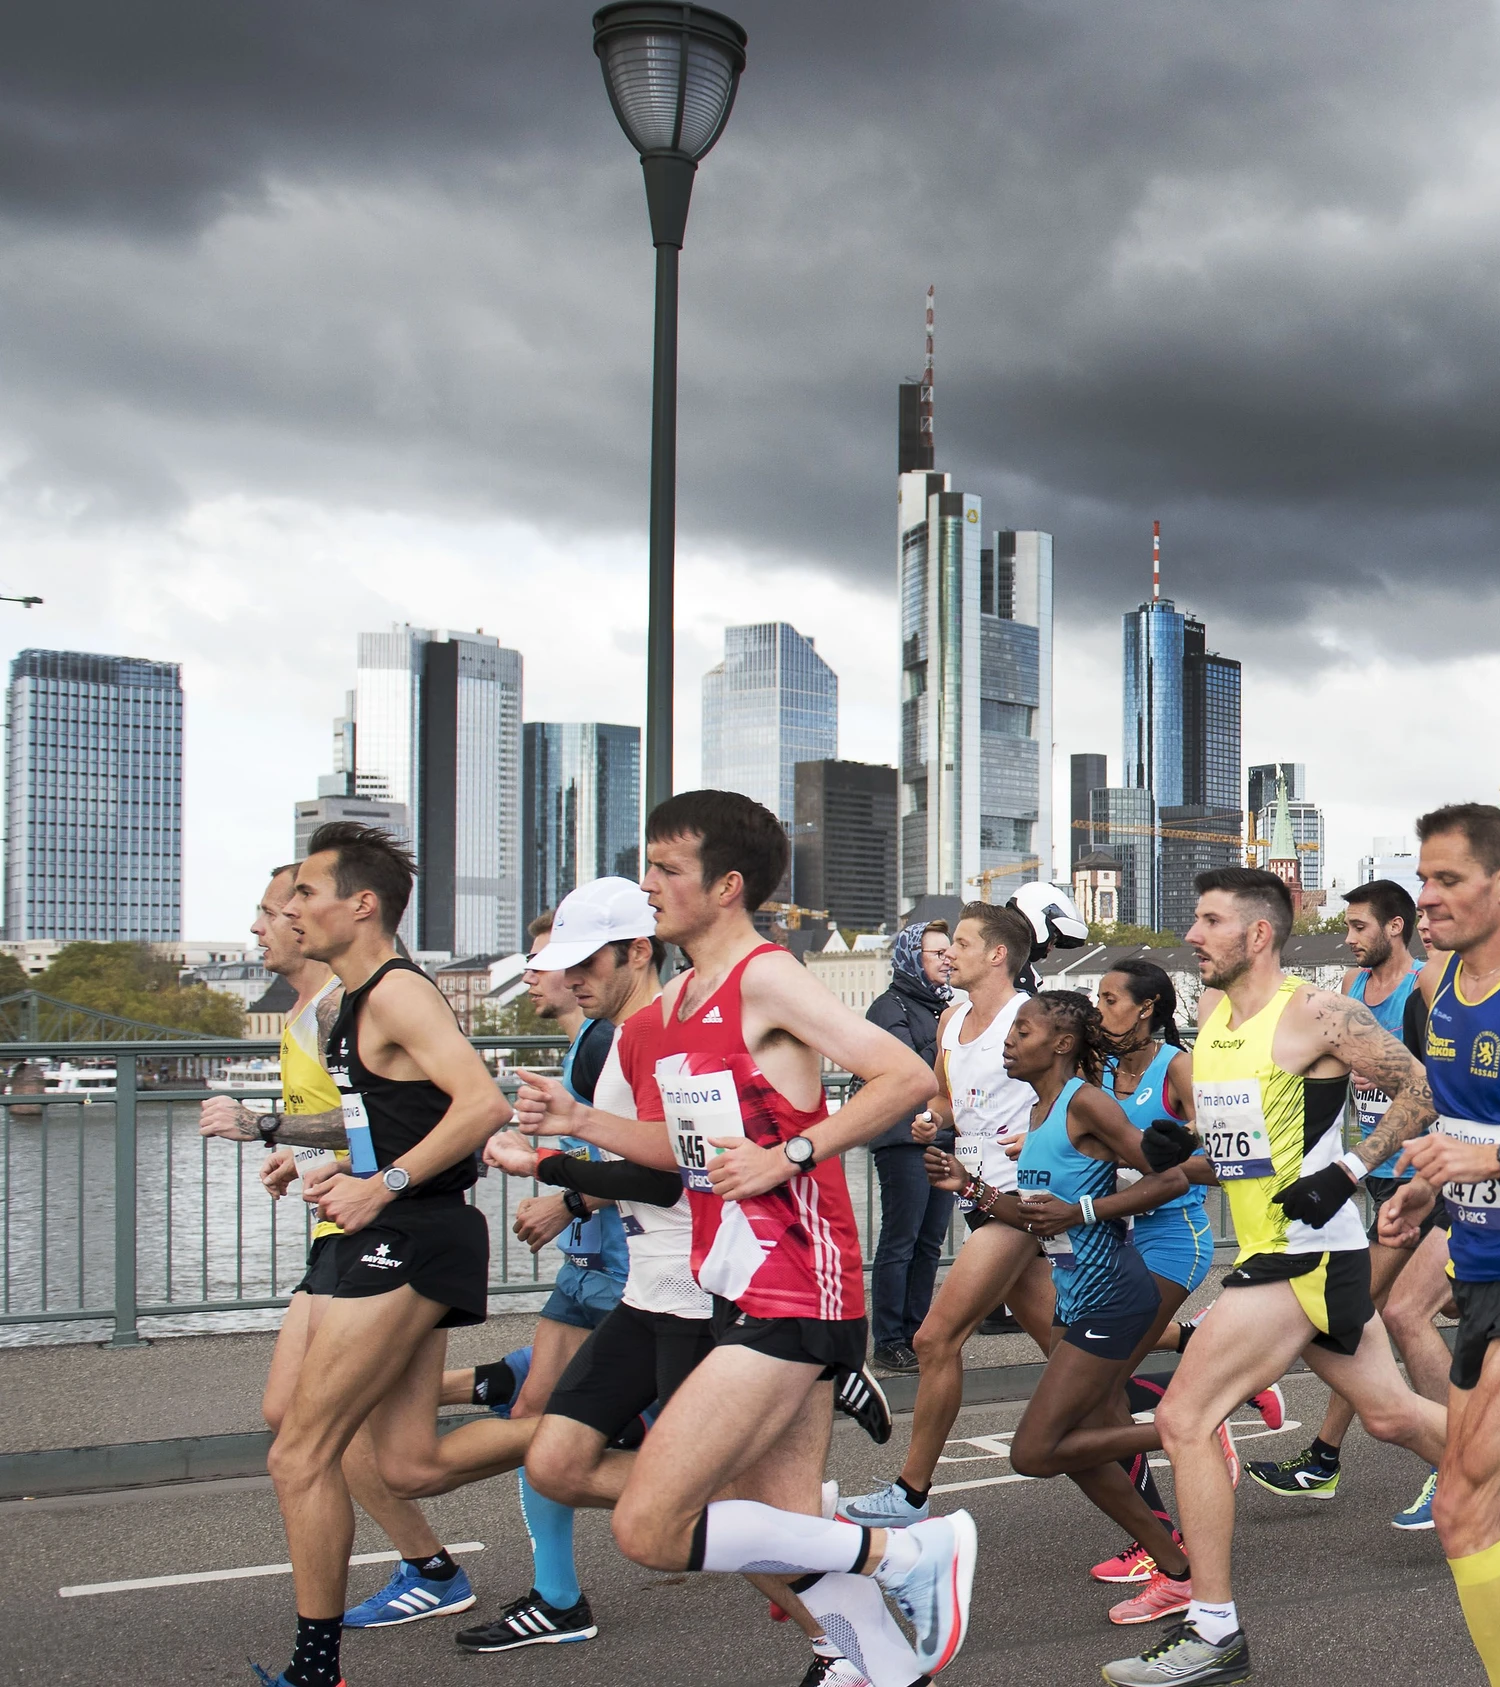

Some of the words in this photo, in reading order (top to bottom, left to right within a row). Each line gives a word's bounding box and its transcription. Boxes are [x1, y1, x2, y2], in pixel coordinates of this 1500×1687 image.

[1470, 1066, 1499, 1079] PASSAU
[666, 1088, 722, 1105] mainova
[1212, 1120, 1227, 1130] Ash
[678, 1135, 706, 1168] 845
[1205, 1131, 1251, 1158] 5276
[1221, 1165, 1245, 1177] asics
